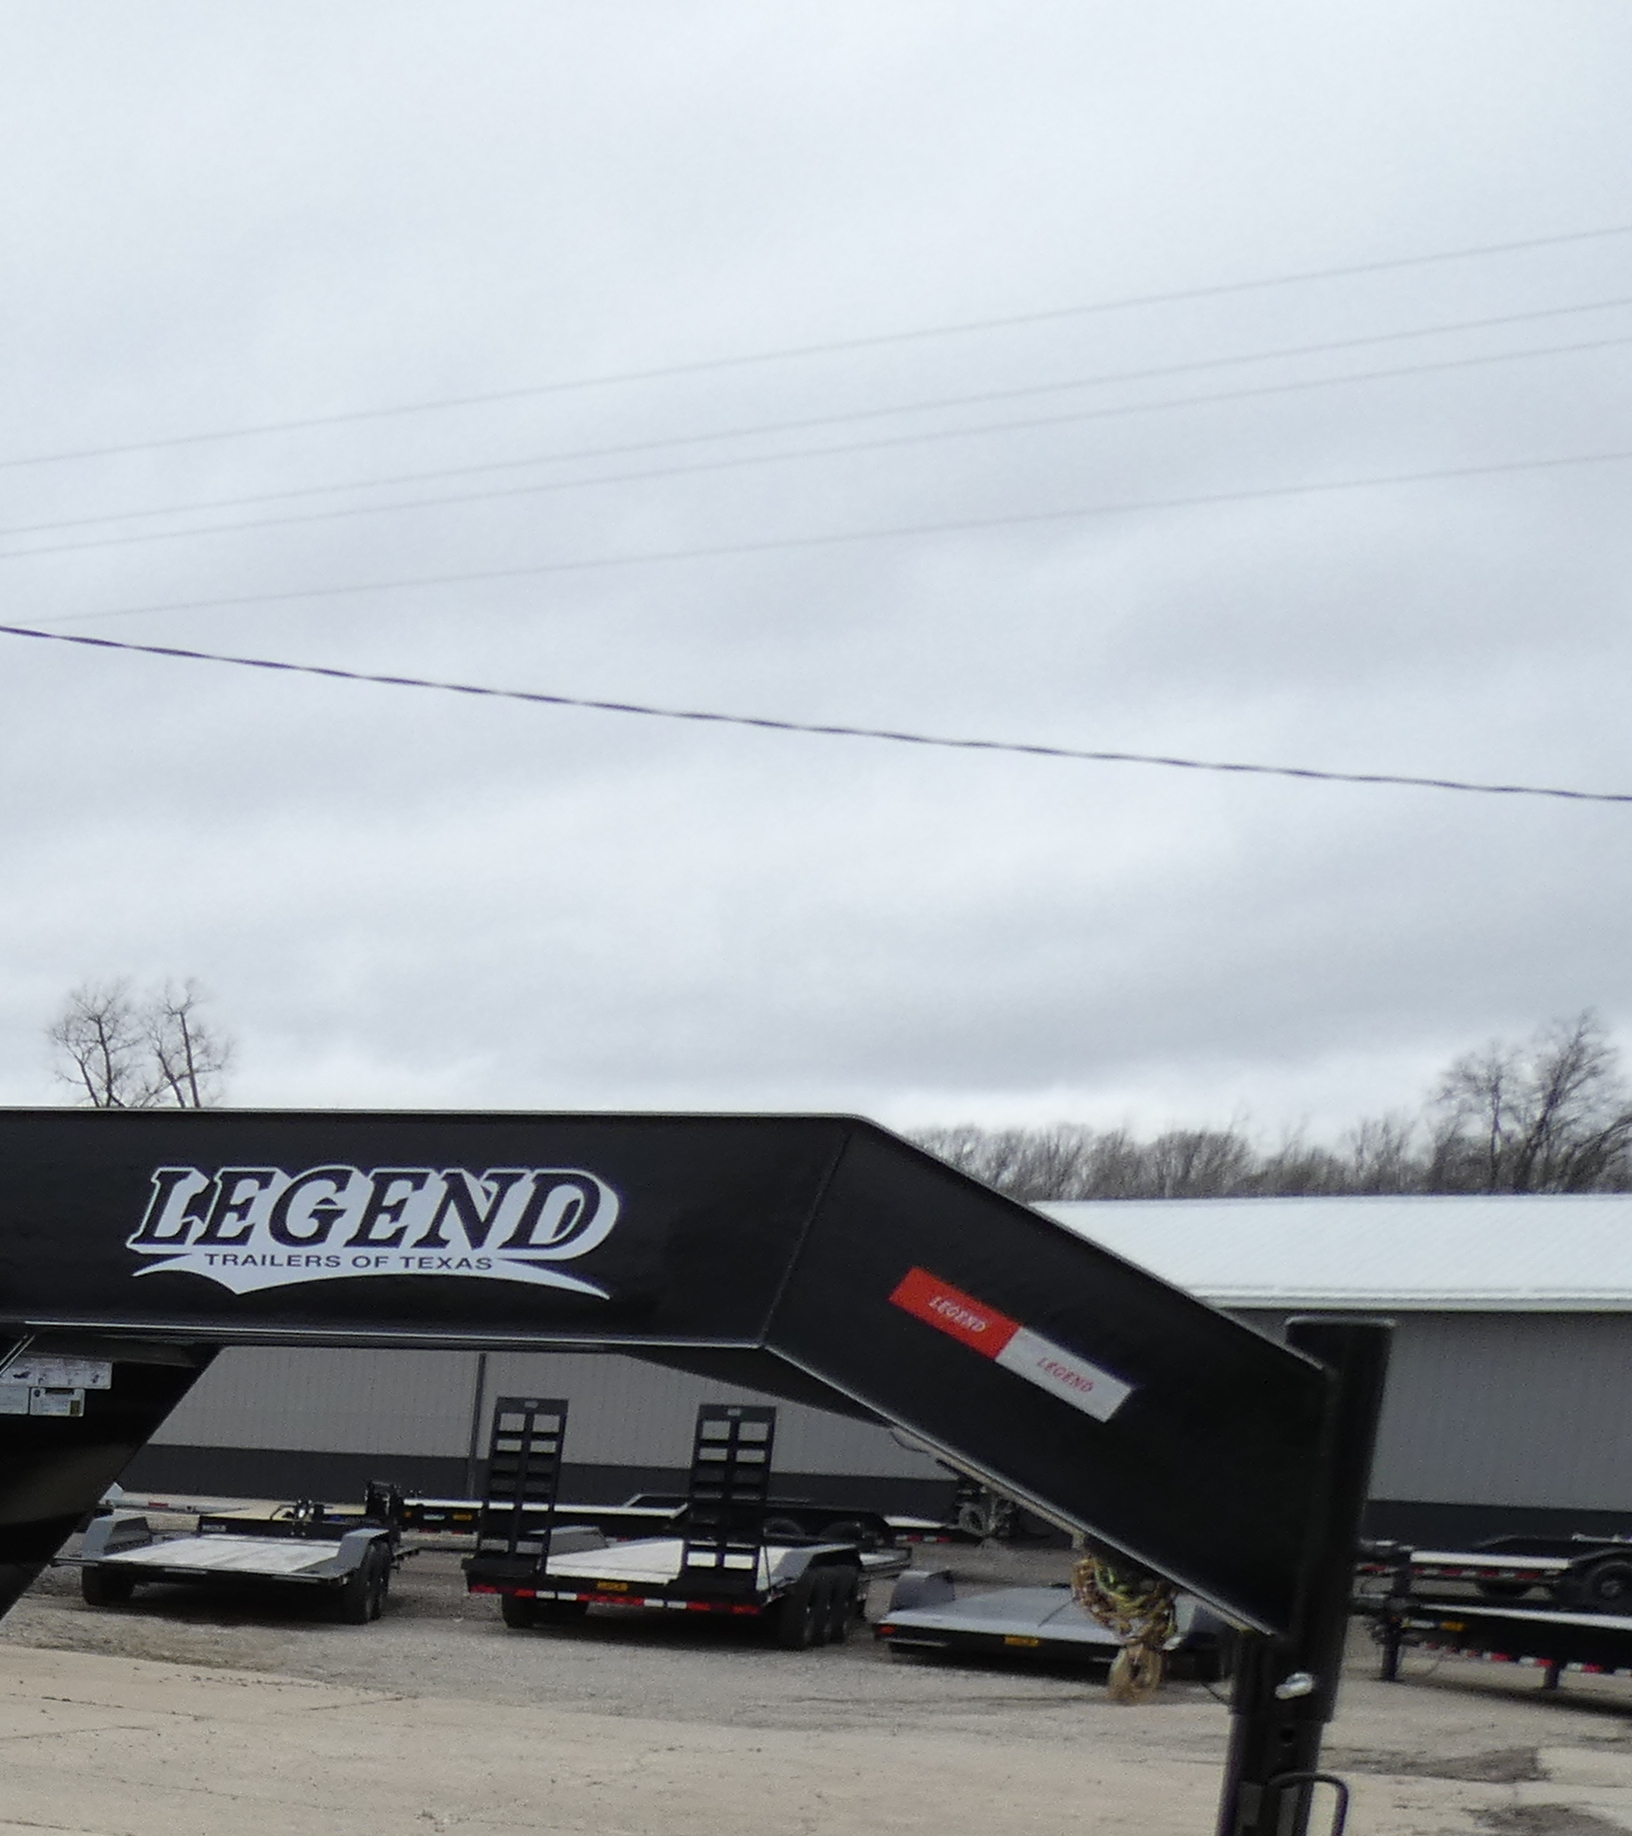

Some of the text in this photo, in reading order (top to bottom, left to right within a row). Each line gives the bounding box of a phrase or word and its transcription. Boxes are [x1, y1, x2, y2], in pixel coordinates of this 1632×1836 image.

[126, 1166, 621, 1261] LEGEND
[205, 1253, 494, 1271] TRAILERS OF TEXAS
[928, 1296, 987, 1333] LEGEND
[1037, 1357, 1096, 1393] LEGEND
